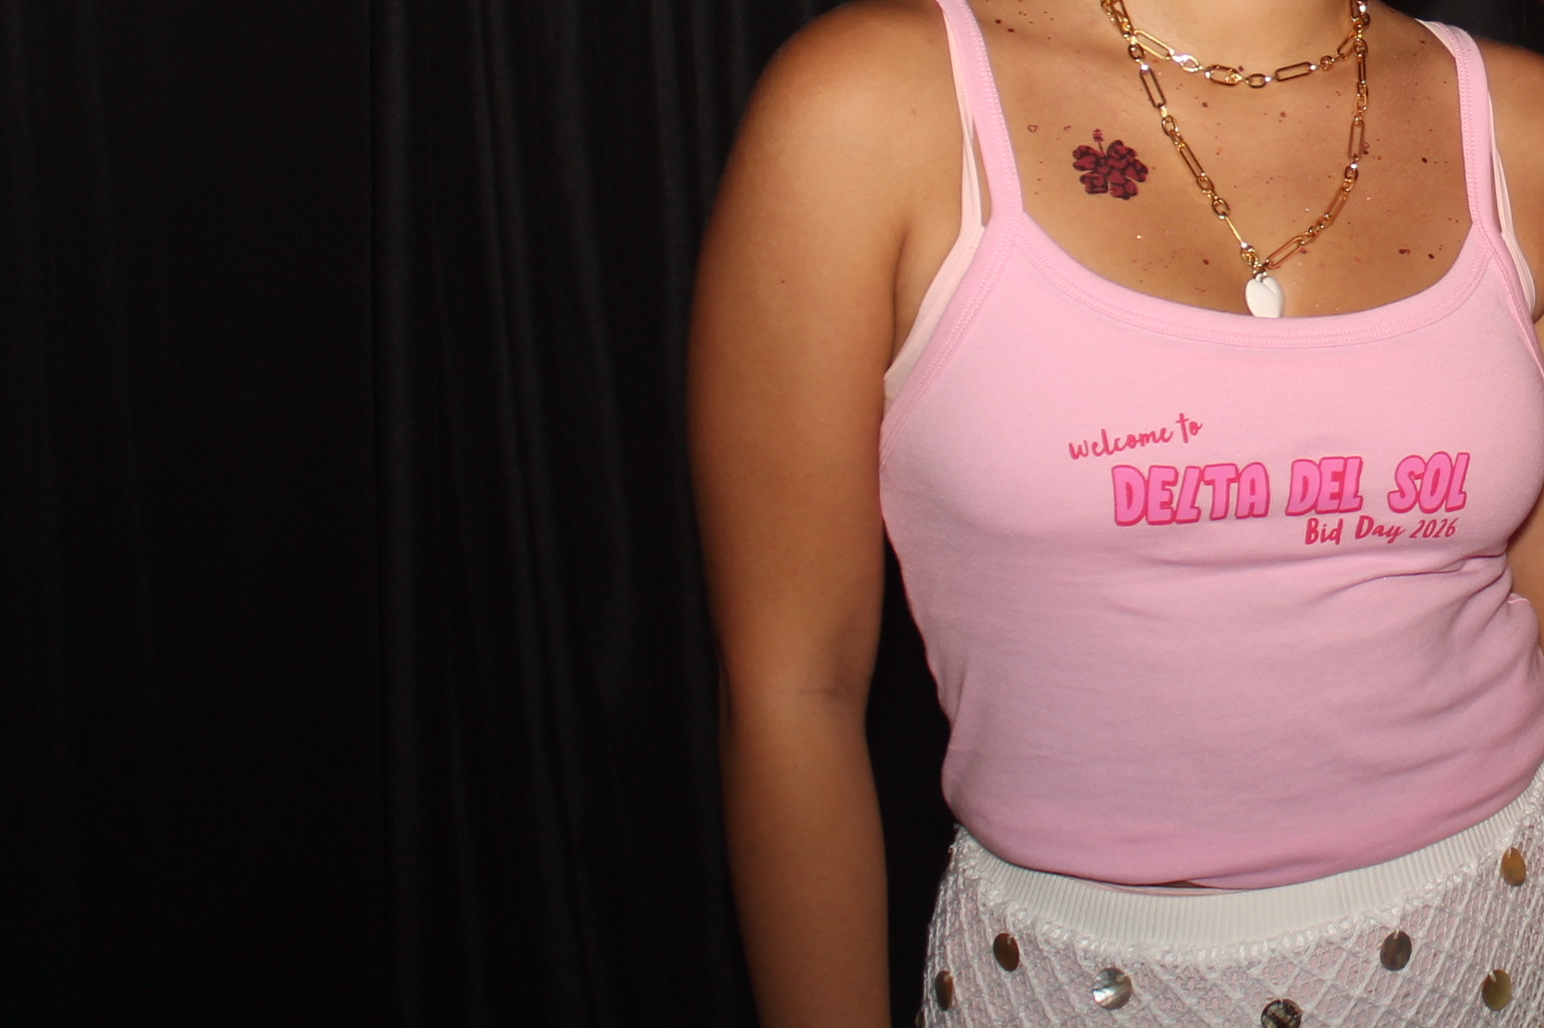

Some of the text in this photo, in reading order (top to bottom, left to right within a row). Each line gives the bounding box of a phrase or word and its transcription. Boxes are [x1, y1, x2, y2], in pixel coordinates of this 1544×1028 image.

[1068, 412, 1203, 460] welcome to
[1111, 451, 1470, 526] DELTA DEL SOL
[1304, 515, 1460, 545] Bid Day 2026
